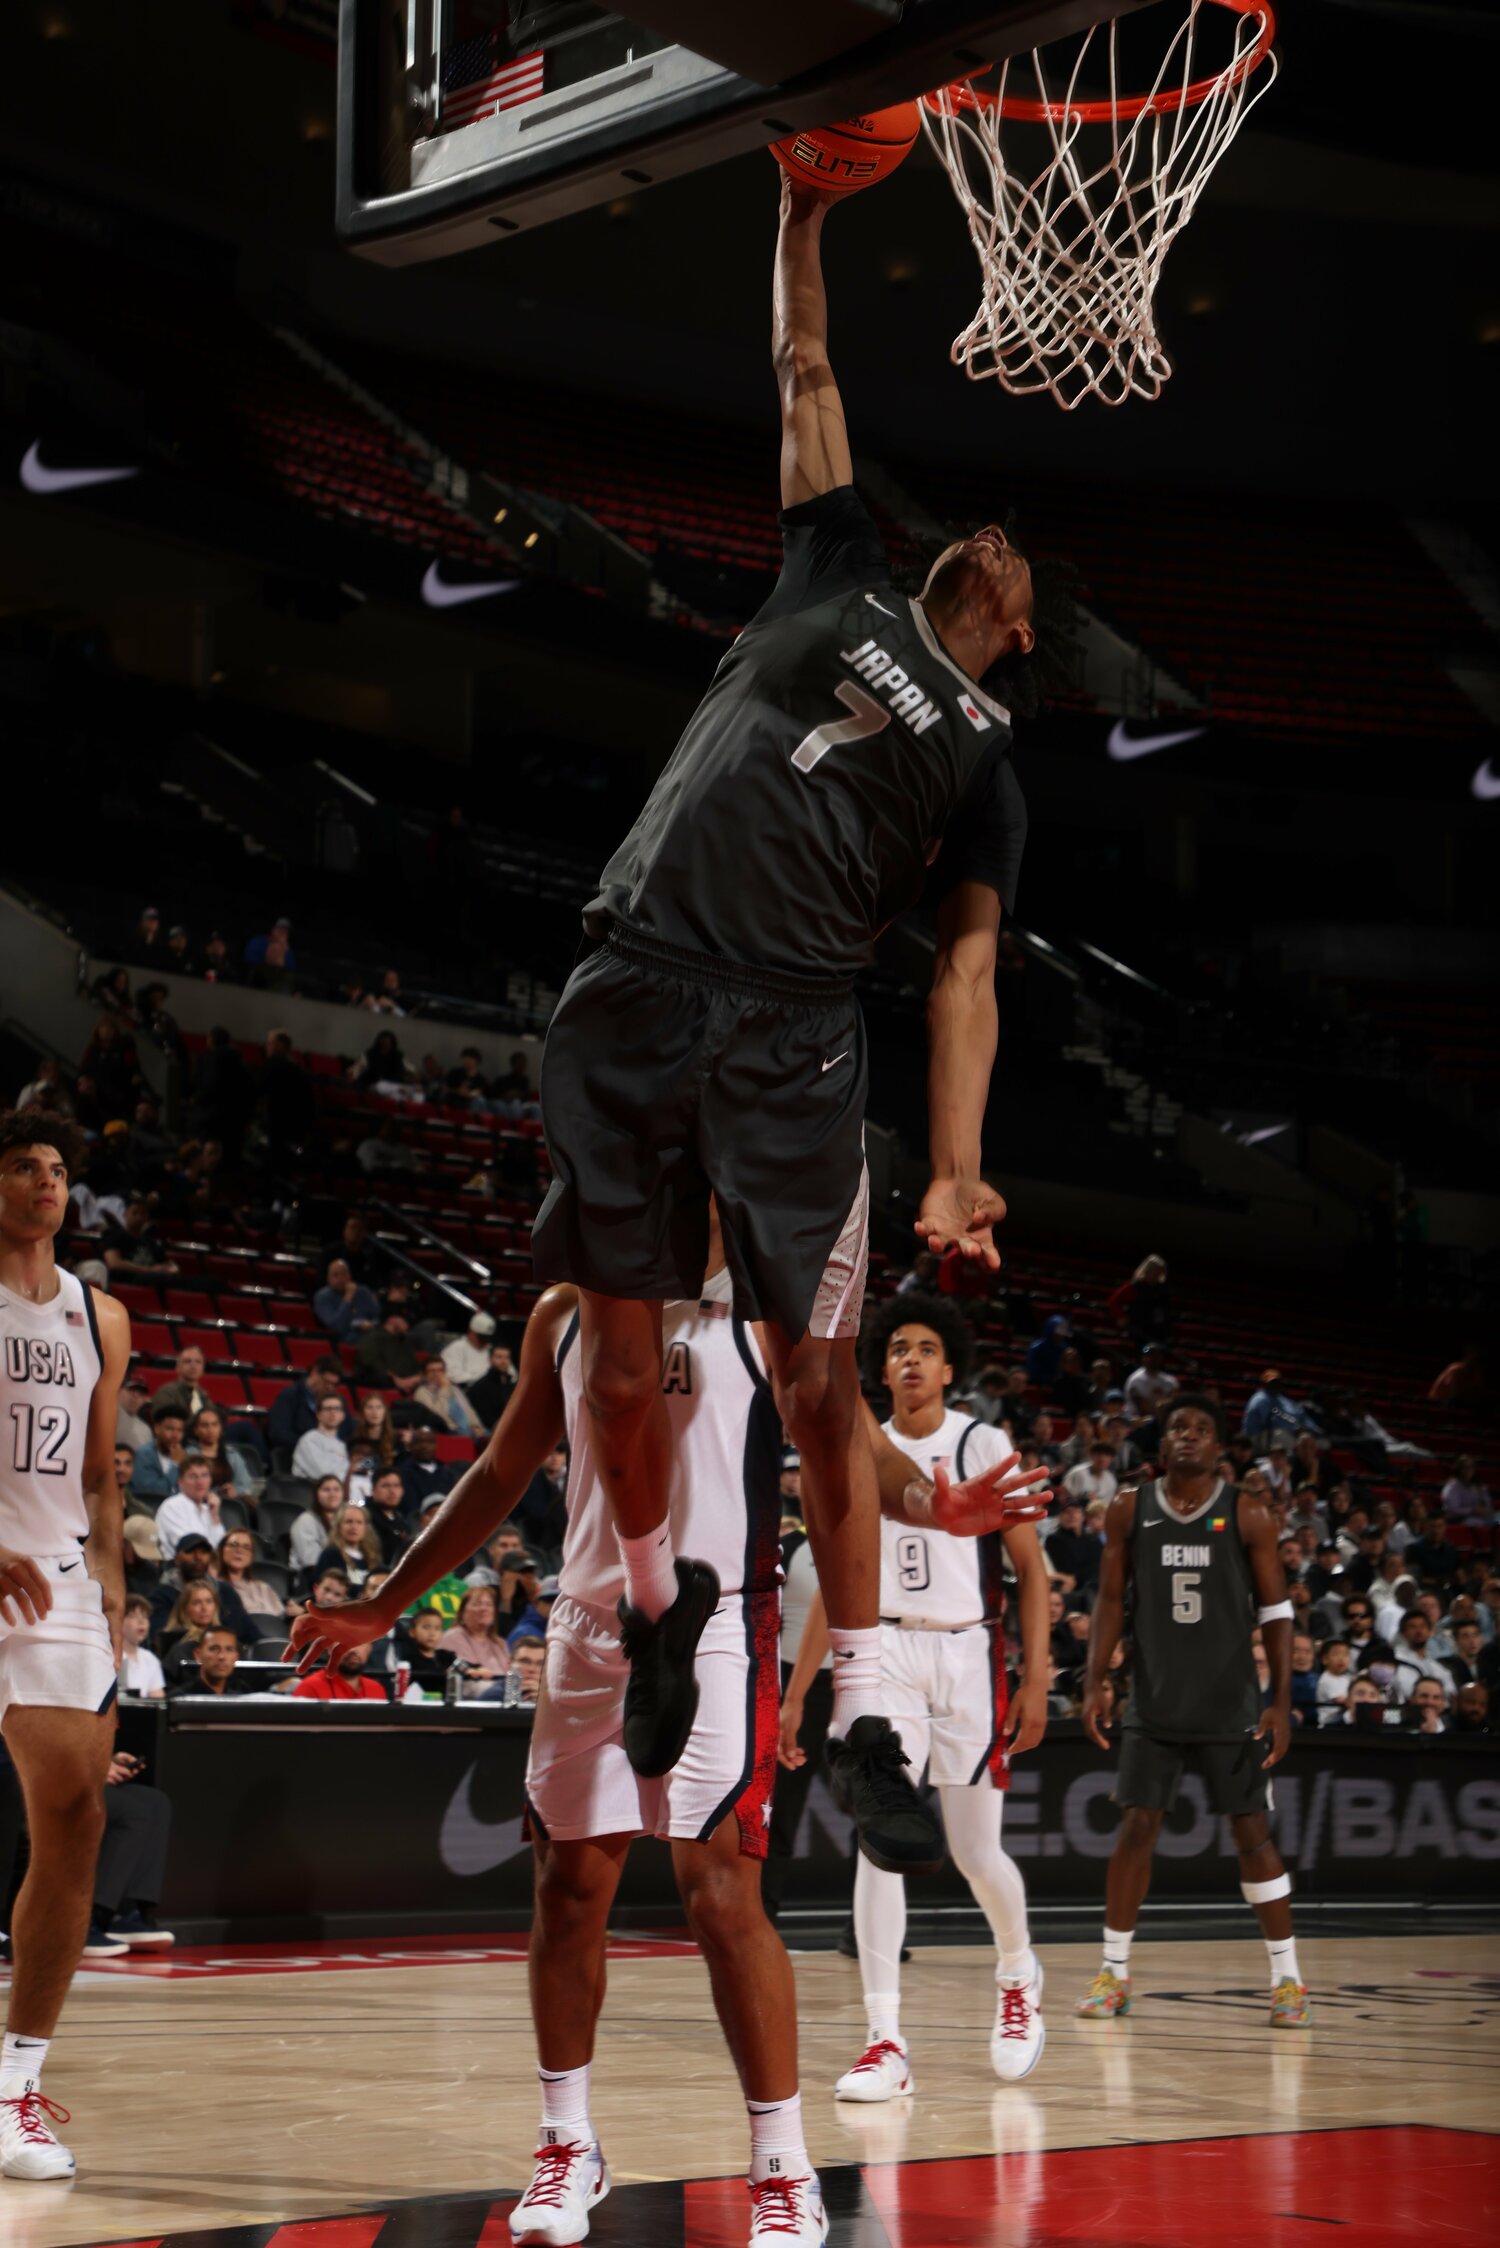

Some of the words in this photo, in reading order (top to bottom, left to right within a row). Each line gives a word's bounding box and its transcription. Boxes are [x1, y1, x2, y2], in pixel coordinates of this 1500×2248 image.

[791, 136, 879, 178] ELITE
[839, 639, 943, 736] JAPAN
[791, 679, 892, 774] 7
[5, 1337, 75, 1387] USA
[10, 1403, 70, 1475] 12
[897, 1535, 930, 1592] 9
[1161, 1544, 1211, 1567] BENIN
[1171, 1572, 1203, 1624] 5
